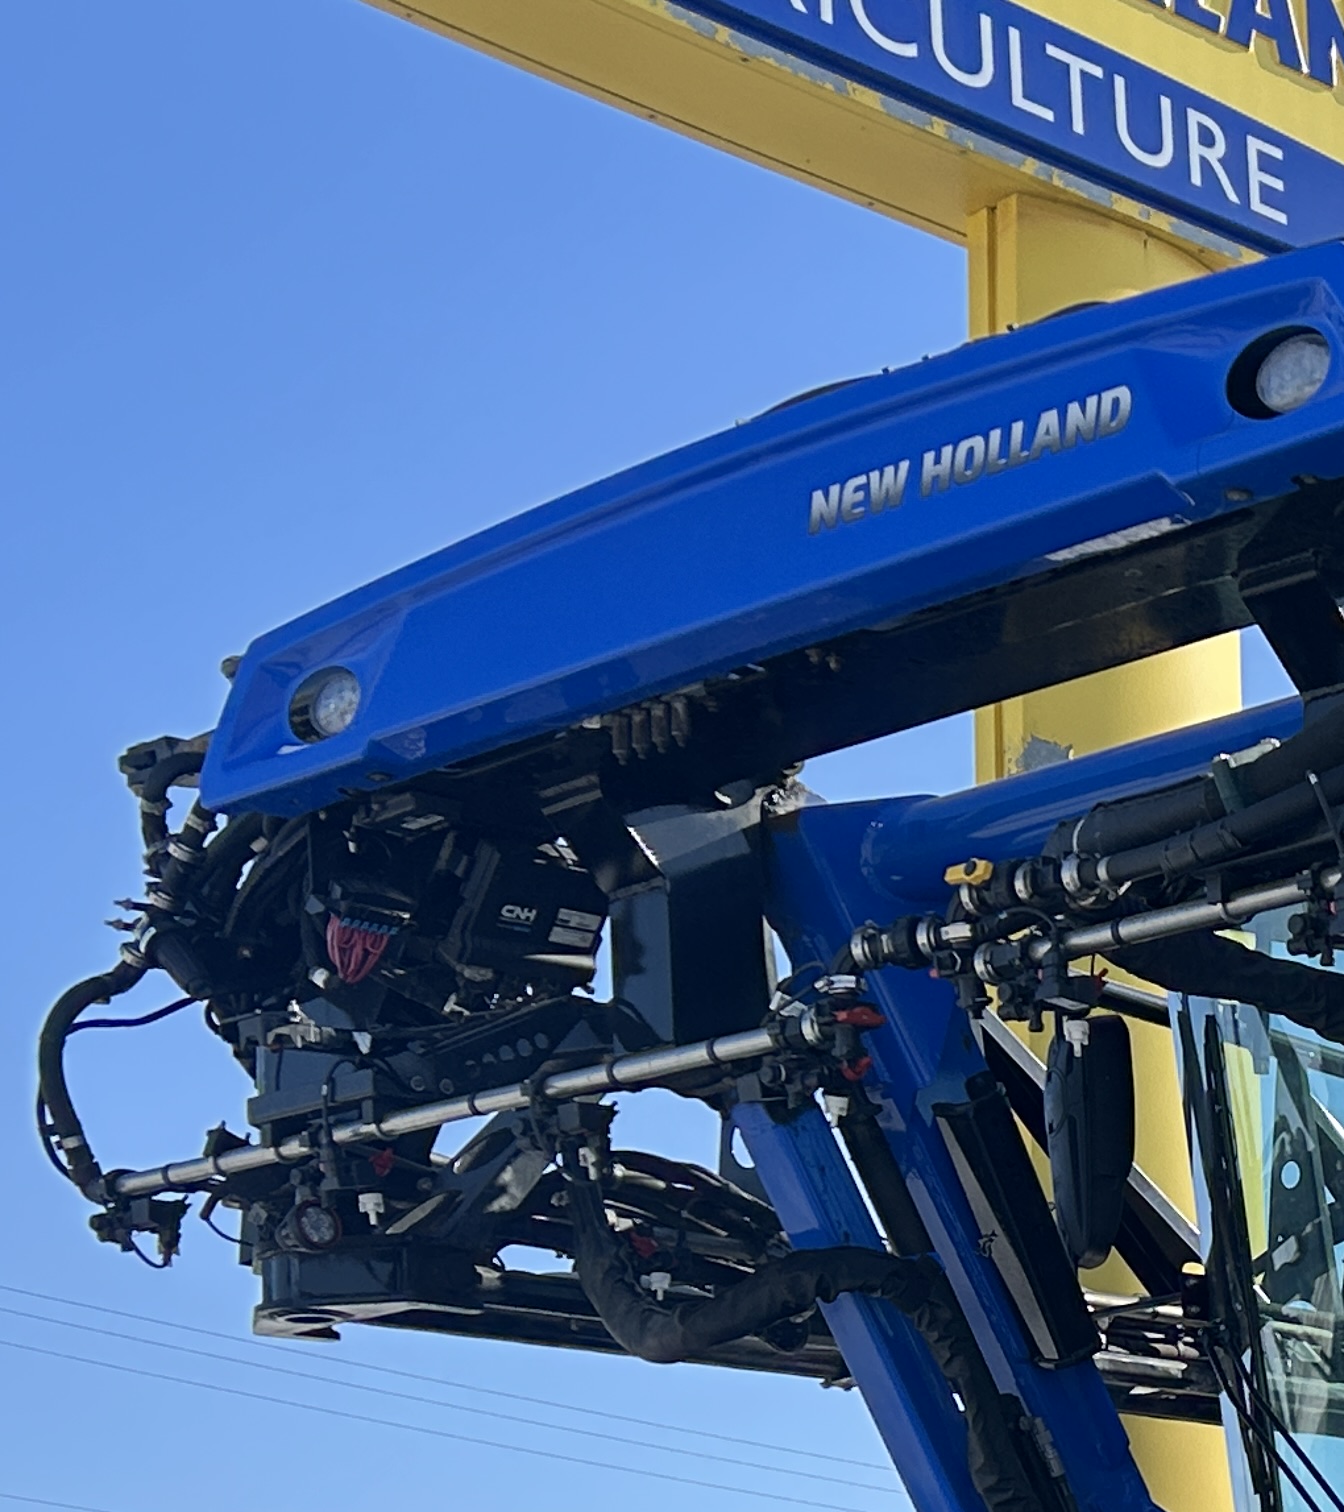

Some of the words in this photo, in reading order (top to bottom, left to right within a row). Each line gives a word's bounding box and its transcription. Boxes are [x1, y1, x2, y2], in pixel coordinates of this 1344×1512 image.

[790, 0, 1289, 226] CULTURE
[808, 459, 910, 536] NEW
[920, 385, 1133, 498] HOLLAND
[500, 904, 538, 923] CNH
